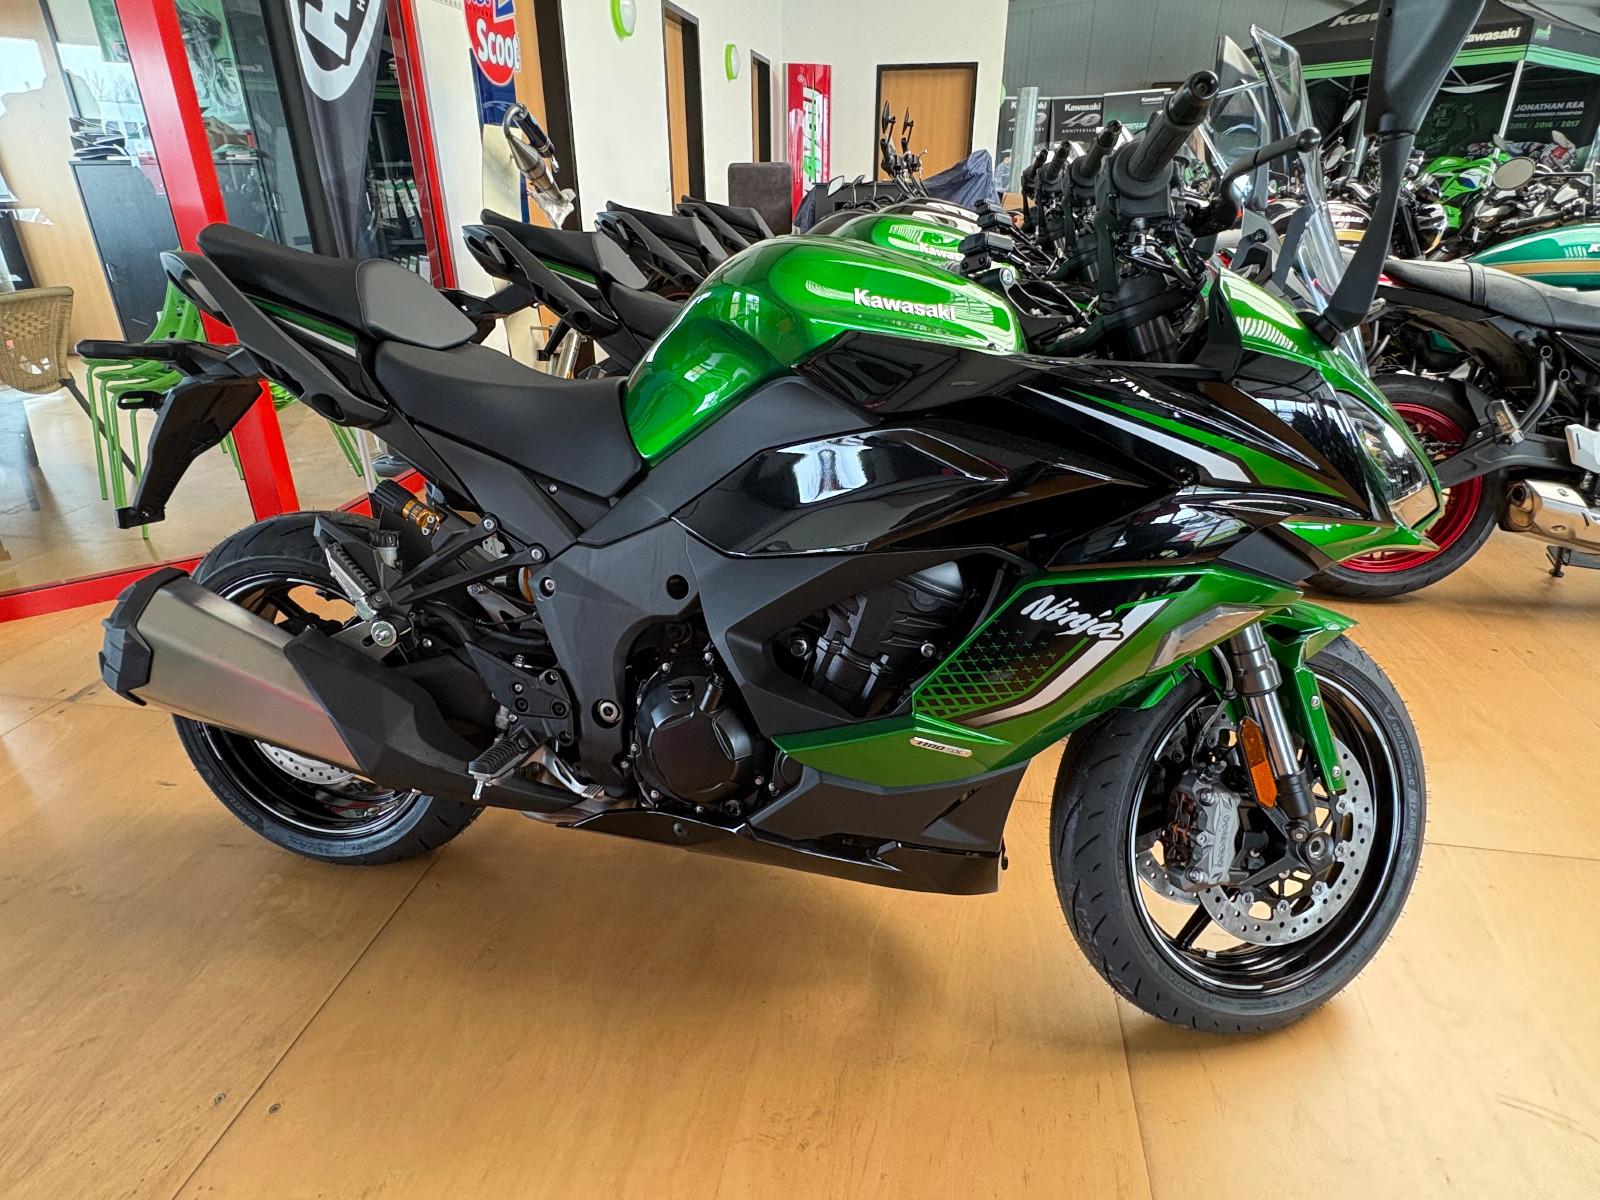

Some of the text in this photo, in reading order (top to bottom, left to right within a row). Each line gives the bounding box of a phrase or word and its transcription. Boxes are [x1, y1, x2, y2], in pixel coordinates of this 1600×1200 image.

[1464, 26, 1521, 43] awasaki
[1064, 102, 1102, 112] Kawasaki
[1515, 100, 1585, 112] JONATHAN REA
[853, 287, 956, 320] Kawasaki
[1020, 594, 1122, 639] Ninja
[1213, 814, 1231, 868] brembo
